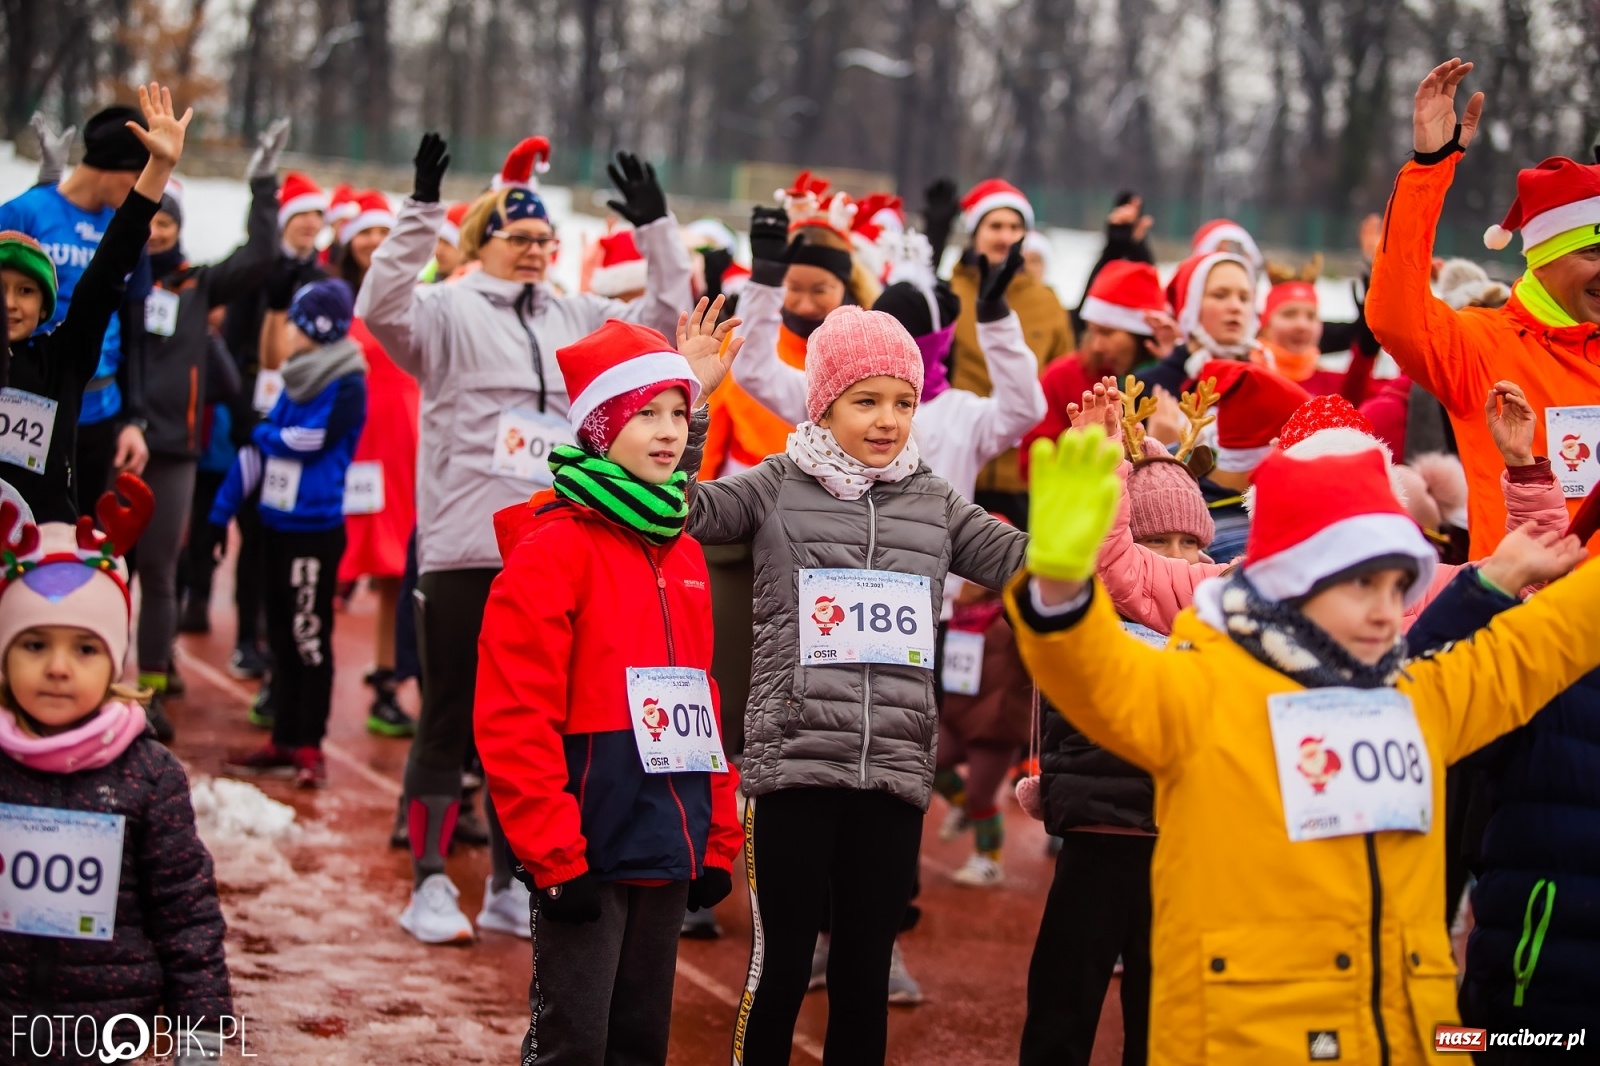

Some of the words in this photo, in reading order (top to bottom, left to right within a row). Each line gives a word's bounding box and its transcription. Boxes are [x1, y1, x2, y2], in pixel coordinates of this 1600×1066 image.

[849, 602, 918, 636] 186
[672, 703, 713, 739] 070
[1352, 740, 1424, 784] 008
[746, 816, 756, 880] CHICAGO
[11, 851, 104, 895] 009
[734, 998, 751, 1051] CHICAGO
